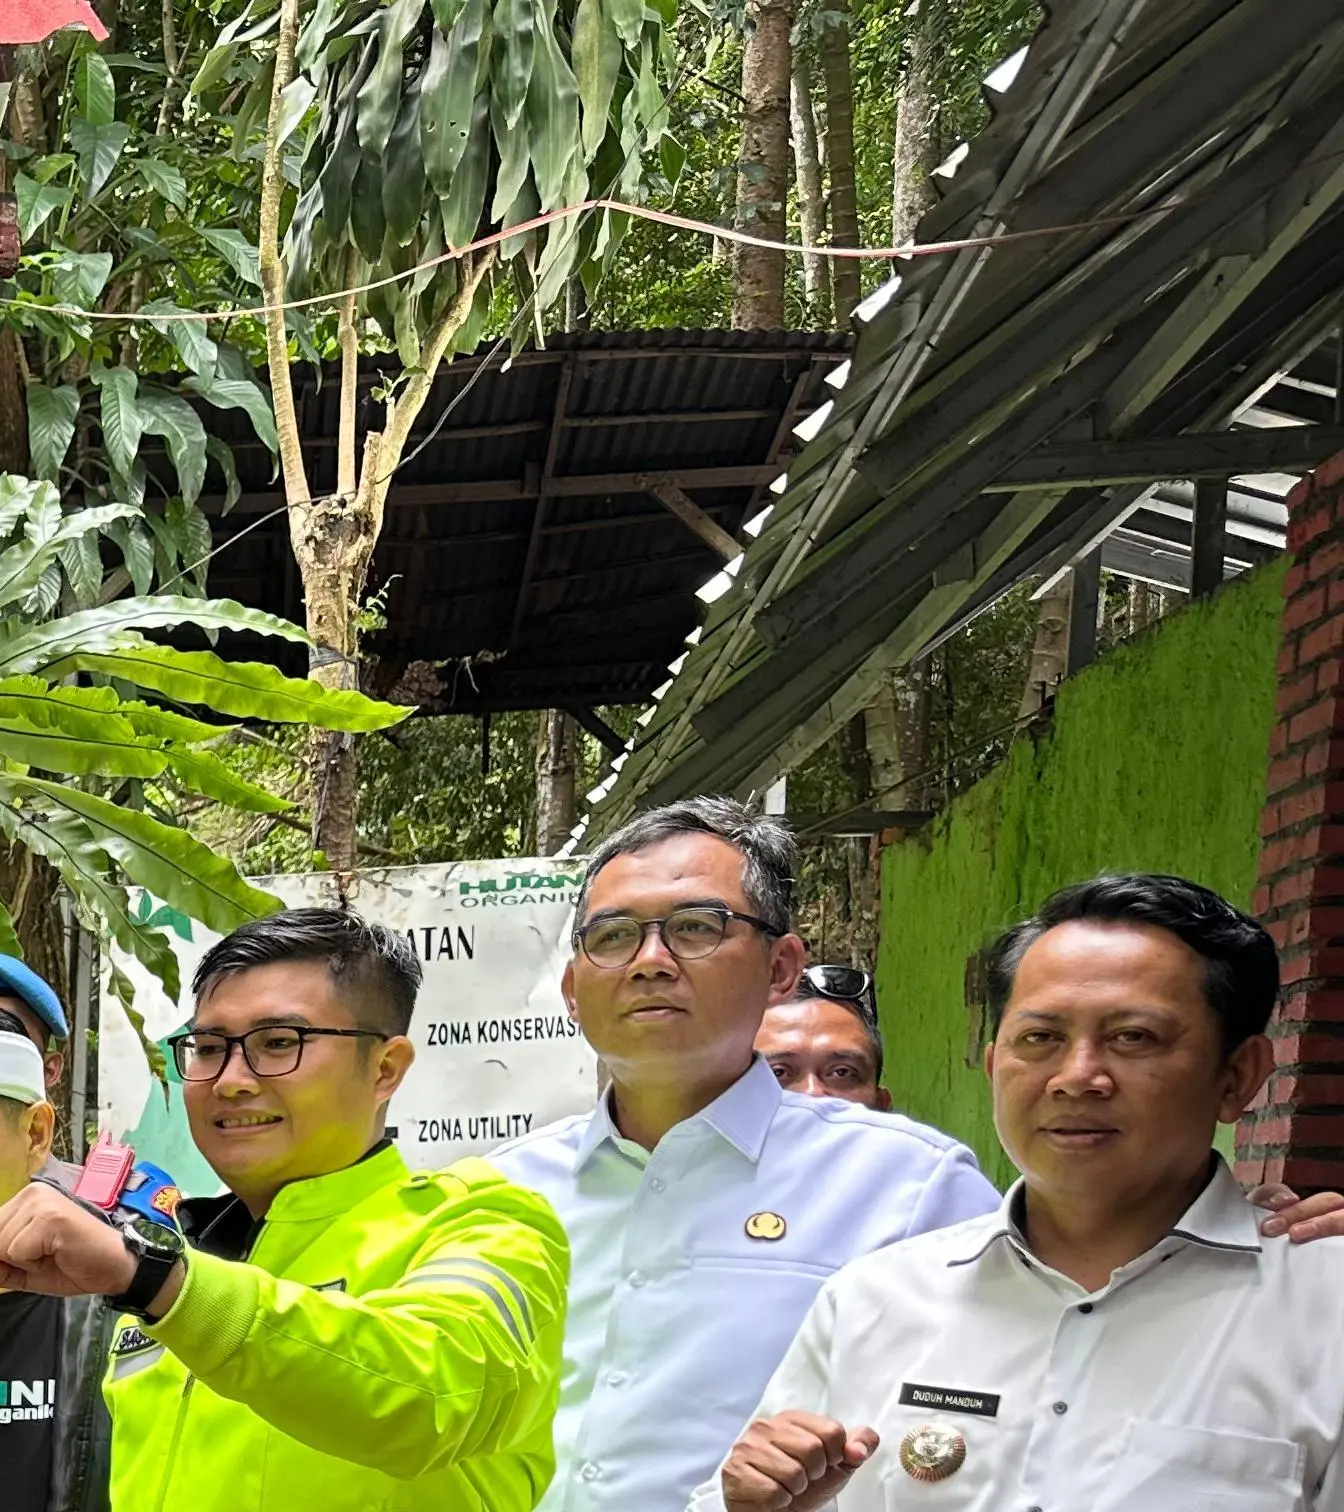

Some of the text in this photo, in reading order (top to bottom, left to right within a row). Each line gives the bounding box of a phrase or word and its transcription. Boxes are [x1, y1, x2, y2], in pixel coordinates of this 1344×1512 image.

[460, 871, 585, 895] HUTAN
[427, 1022, 472, 1046] ZONA
[418, 1113, 533, 1143] ZONA UTILITY
